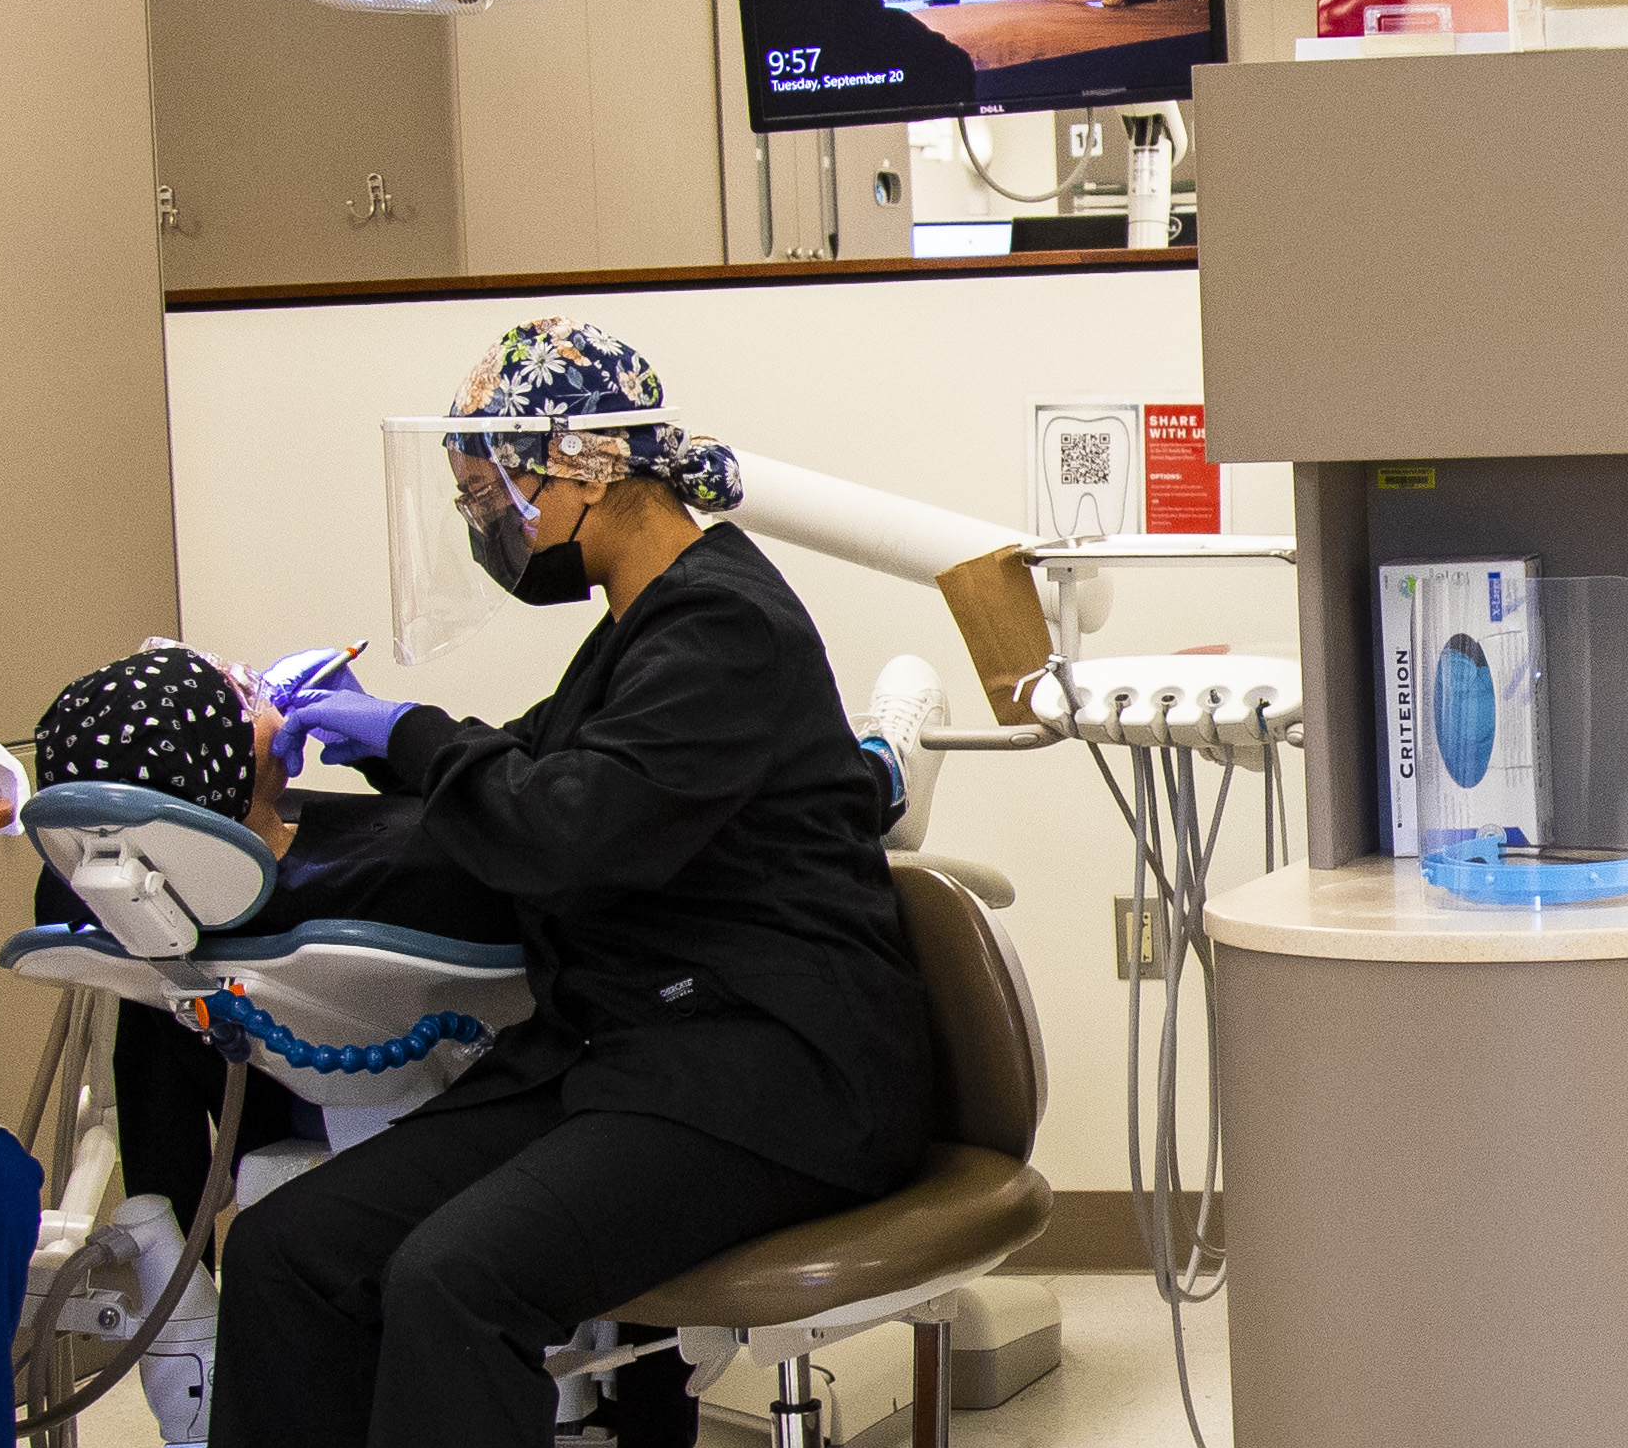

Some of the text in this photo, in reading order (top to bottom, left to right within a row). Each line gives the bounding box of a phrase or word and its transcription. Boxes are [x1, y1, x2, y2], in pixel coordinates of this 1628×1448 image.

[768, 47, 821, 76] 9:57
[771, 69, 904, 92] Tuesday, September 20
[980, 104, 1005, 114] DELL
[1149, 415, 1197, 427] SHARE
[1149, 428, 1187, 439] WITH
[1396, 650, 1414, 779] CRITERION
